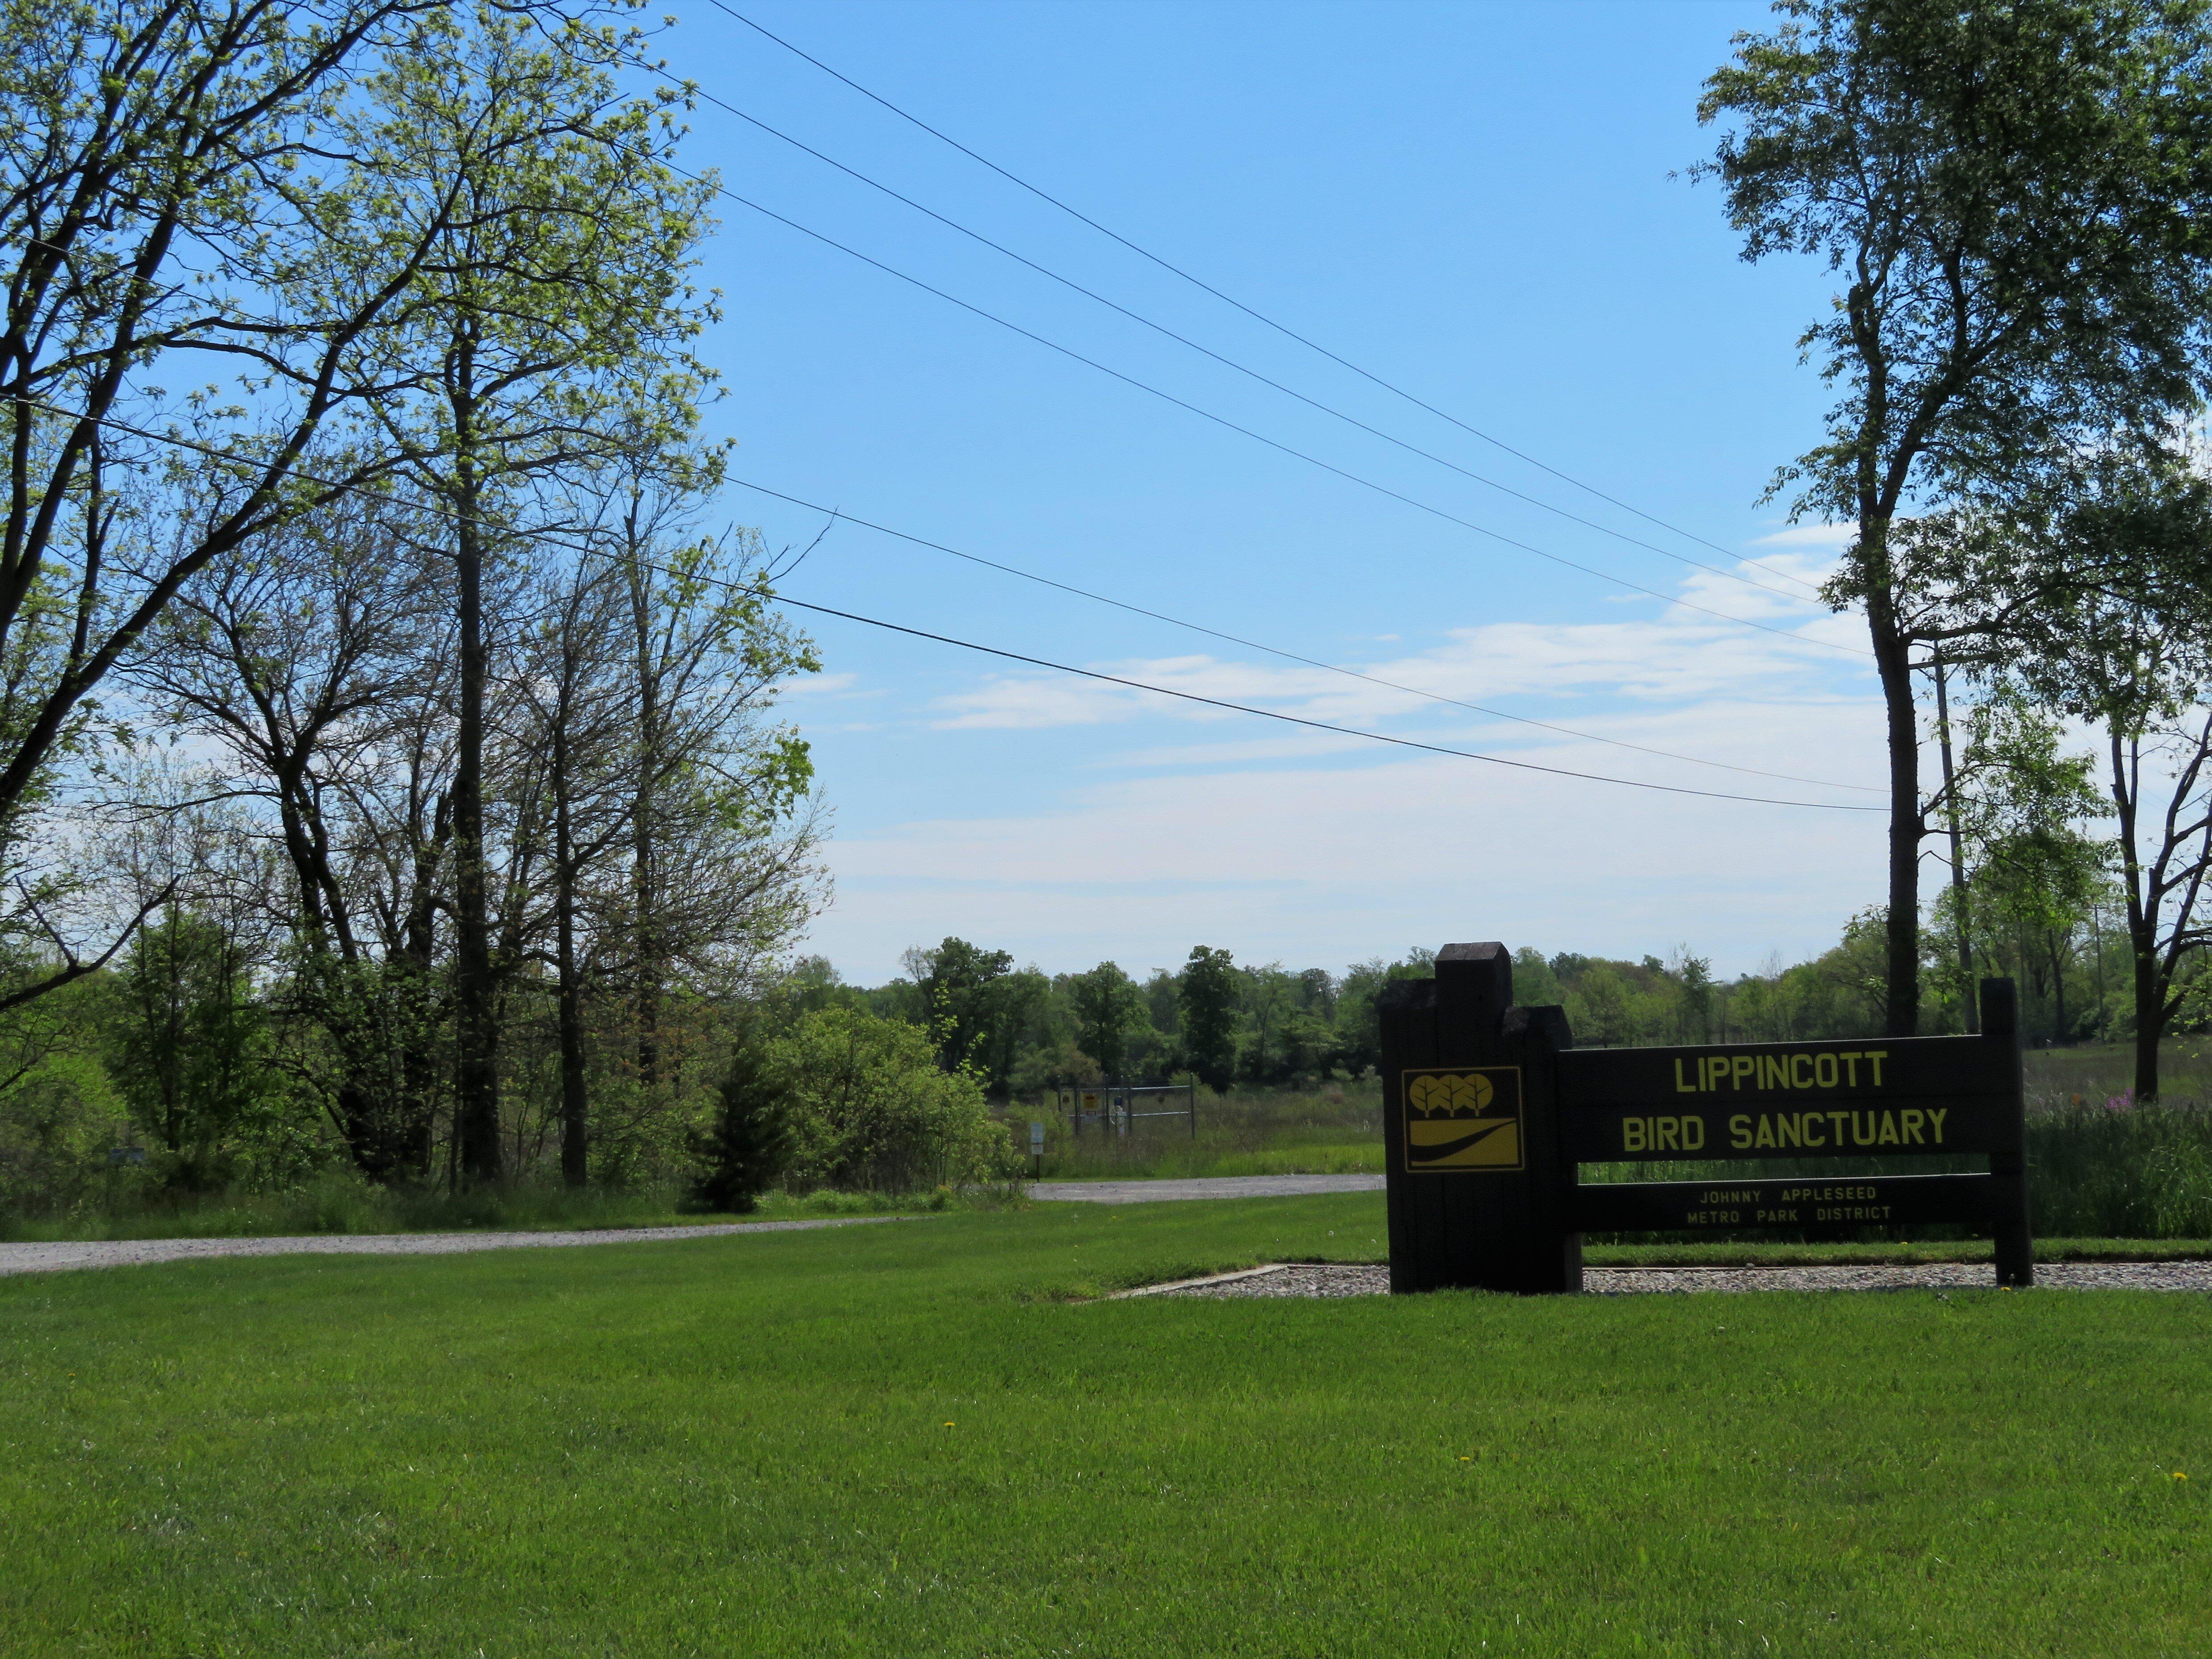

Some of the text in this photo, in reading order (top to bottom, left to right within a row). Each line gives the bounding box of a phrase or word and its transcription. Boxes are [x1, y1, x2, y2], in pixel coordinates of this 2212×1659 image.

[1676, 1051, 1887, 1092] LIPPINCOTT
[1623, 1108, 1946, 1151] BIRD SANCTUARY
[1700, 1187, 1877, 1204] JOHNNY APPLESEED
[1688, 1206, 1891, 1224] METRO PARK DISTRICT
